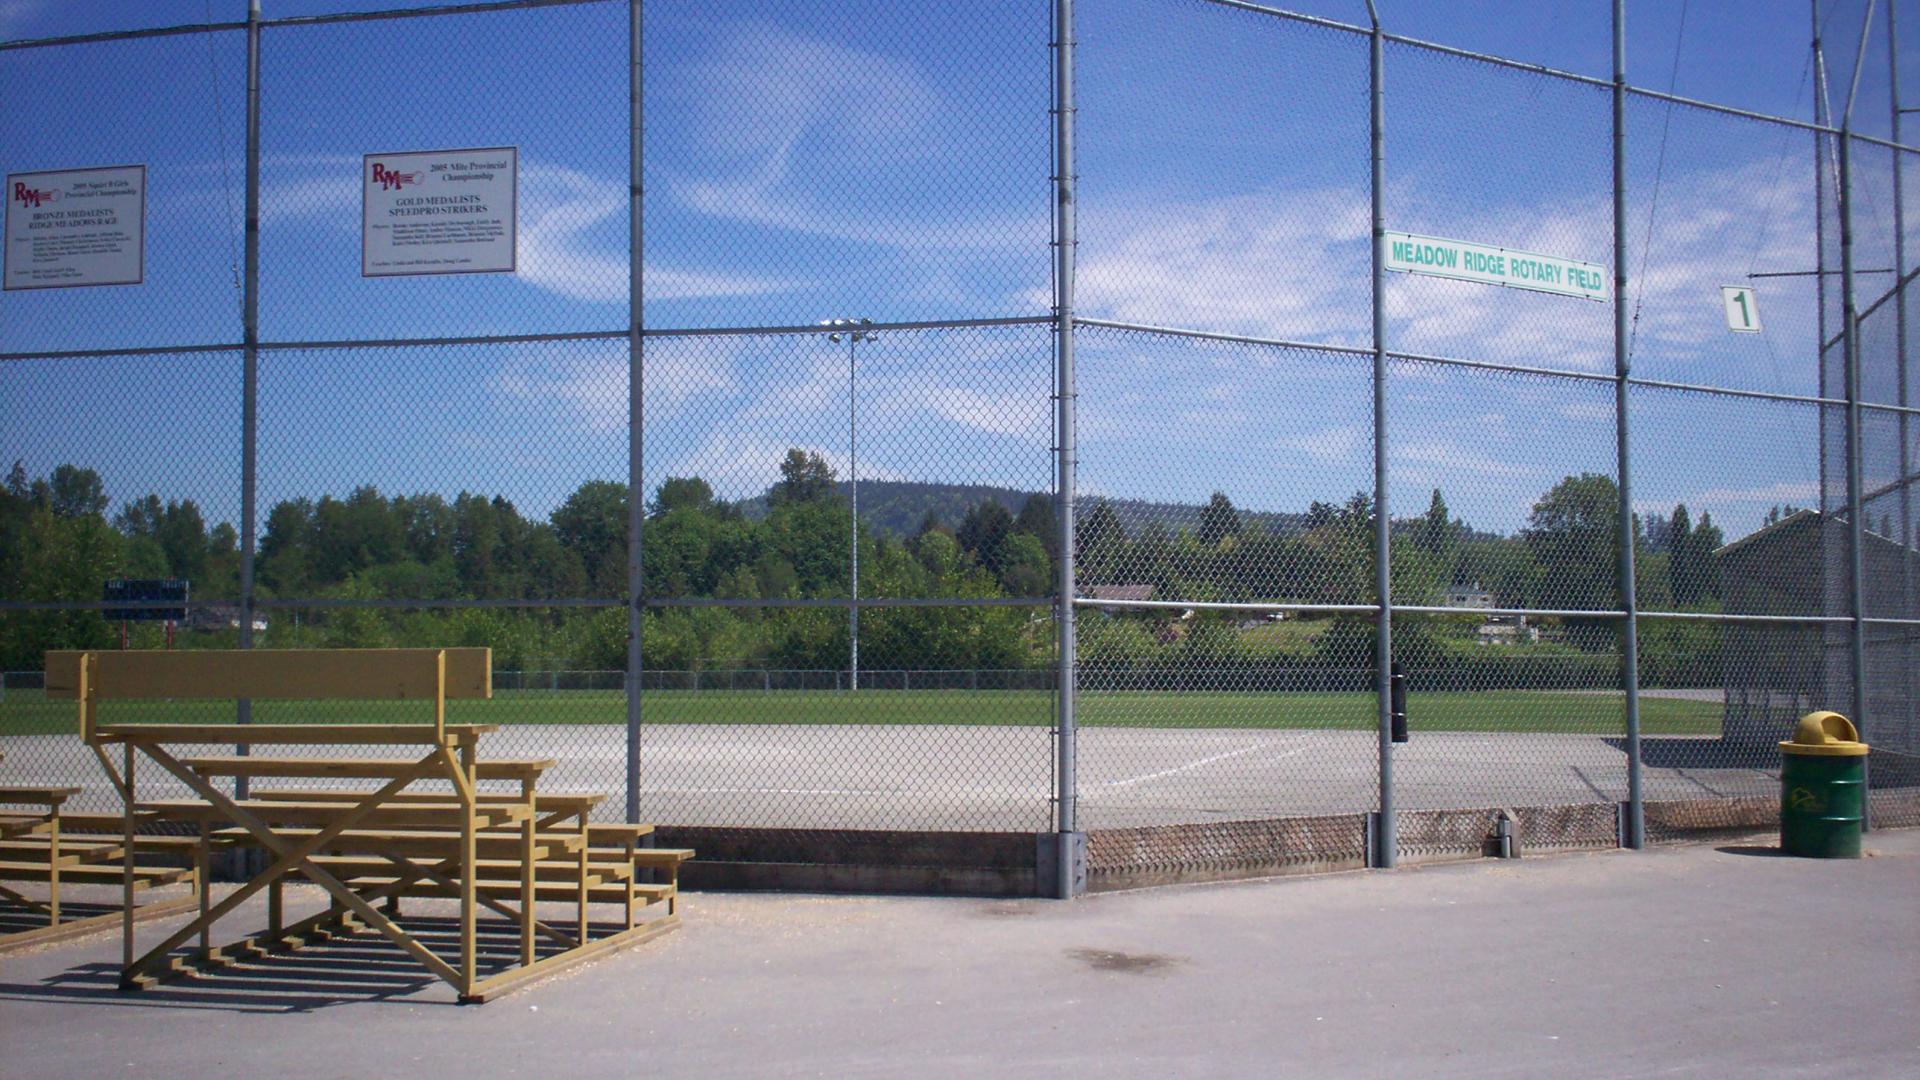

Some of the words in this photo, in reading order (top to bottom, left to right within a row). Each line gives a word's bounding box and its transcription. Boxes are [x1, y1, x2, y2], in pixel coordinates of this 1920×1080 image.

[470, 161, 507, 170] Provincial
[442, 172, 494, 182] Championship
[396, 197, 424, 206] GOLD
[425, 195, 481, 205] MEDALISTS
[66, 209, 114, 218] MEDALISTS
[389, 206, 440, 217] SPEEDPRO
[441, 205, 488, 214] STRIKERS
[1393, 241, 1457, 268] MEADOW
[1464, 251, 1505, 276] RIDGE
[1511, 258, 1561, 284] ROTARY
[1568, 267, 1602, 290] FIELD
[1733, 291, 1750, 327] 1
